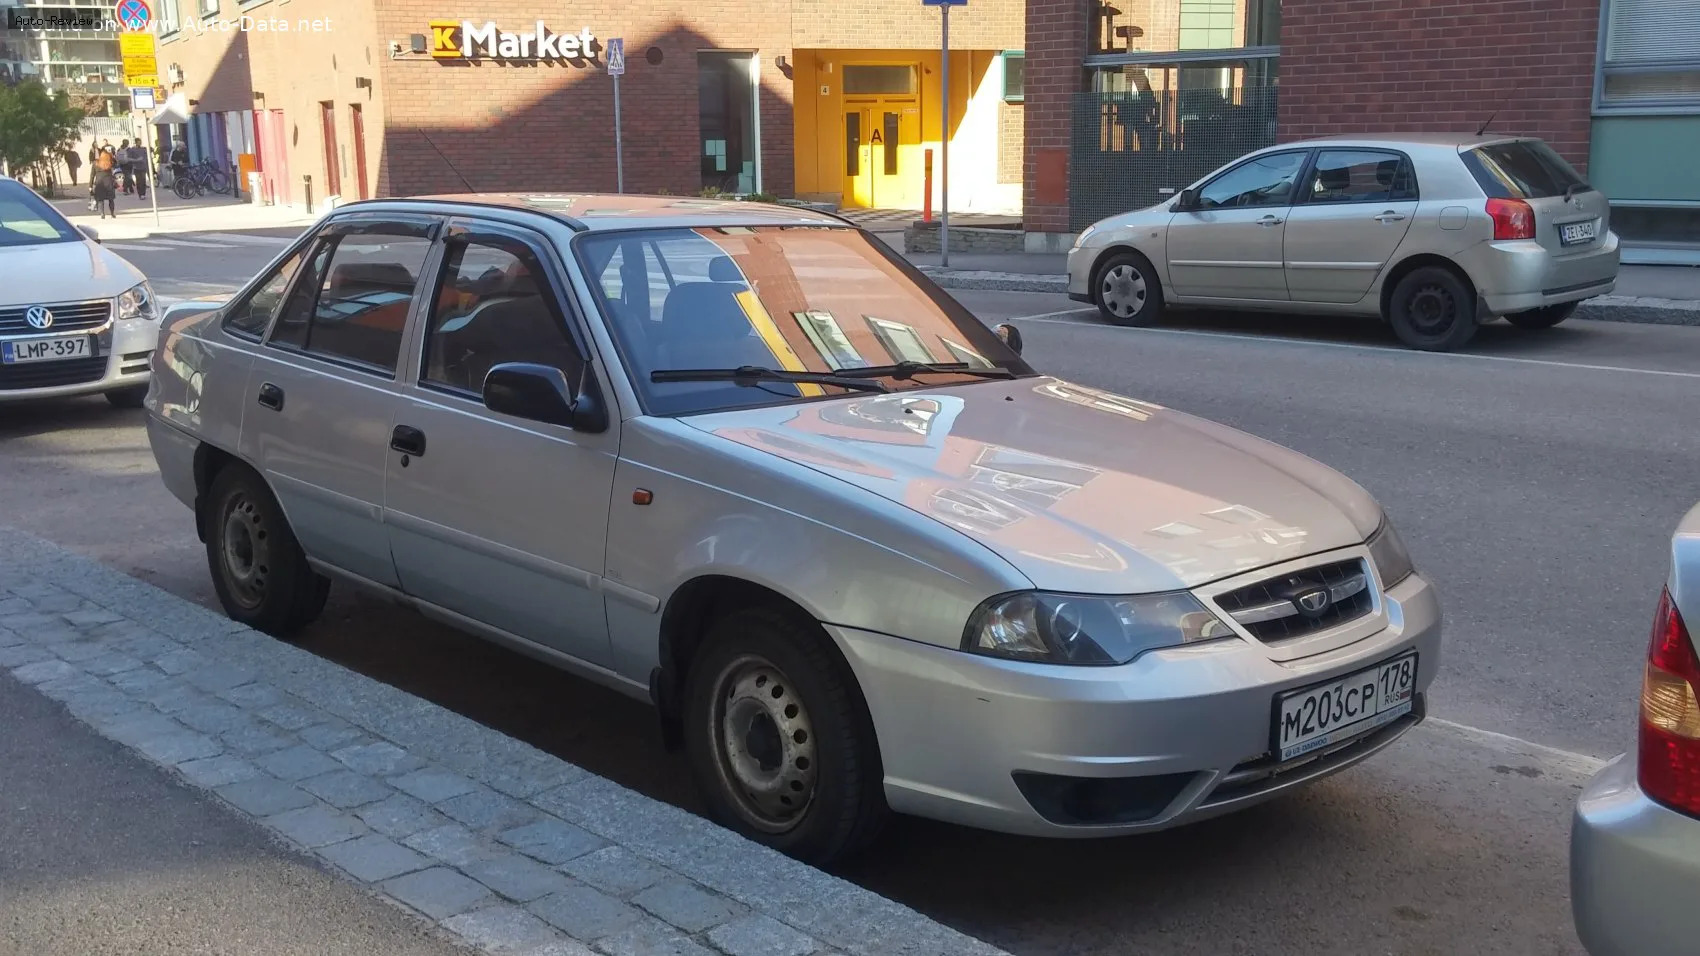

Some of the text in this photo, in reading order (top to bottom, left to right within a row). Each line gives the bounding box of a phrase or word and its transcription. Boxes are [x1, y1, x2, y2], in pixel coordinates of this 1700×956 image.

[431, 20, 595, 58] K Market
[871, 128, 882, 143] A
[16, 338, 85, 359] LMP-397
[1284, 683, 1375, 742] M203CP
[1380, 660, 1411, 695] 178
[1384, 691, 1400, 706] RUS
